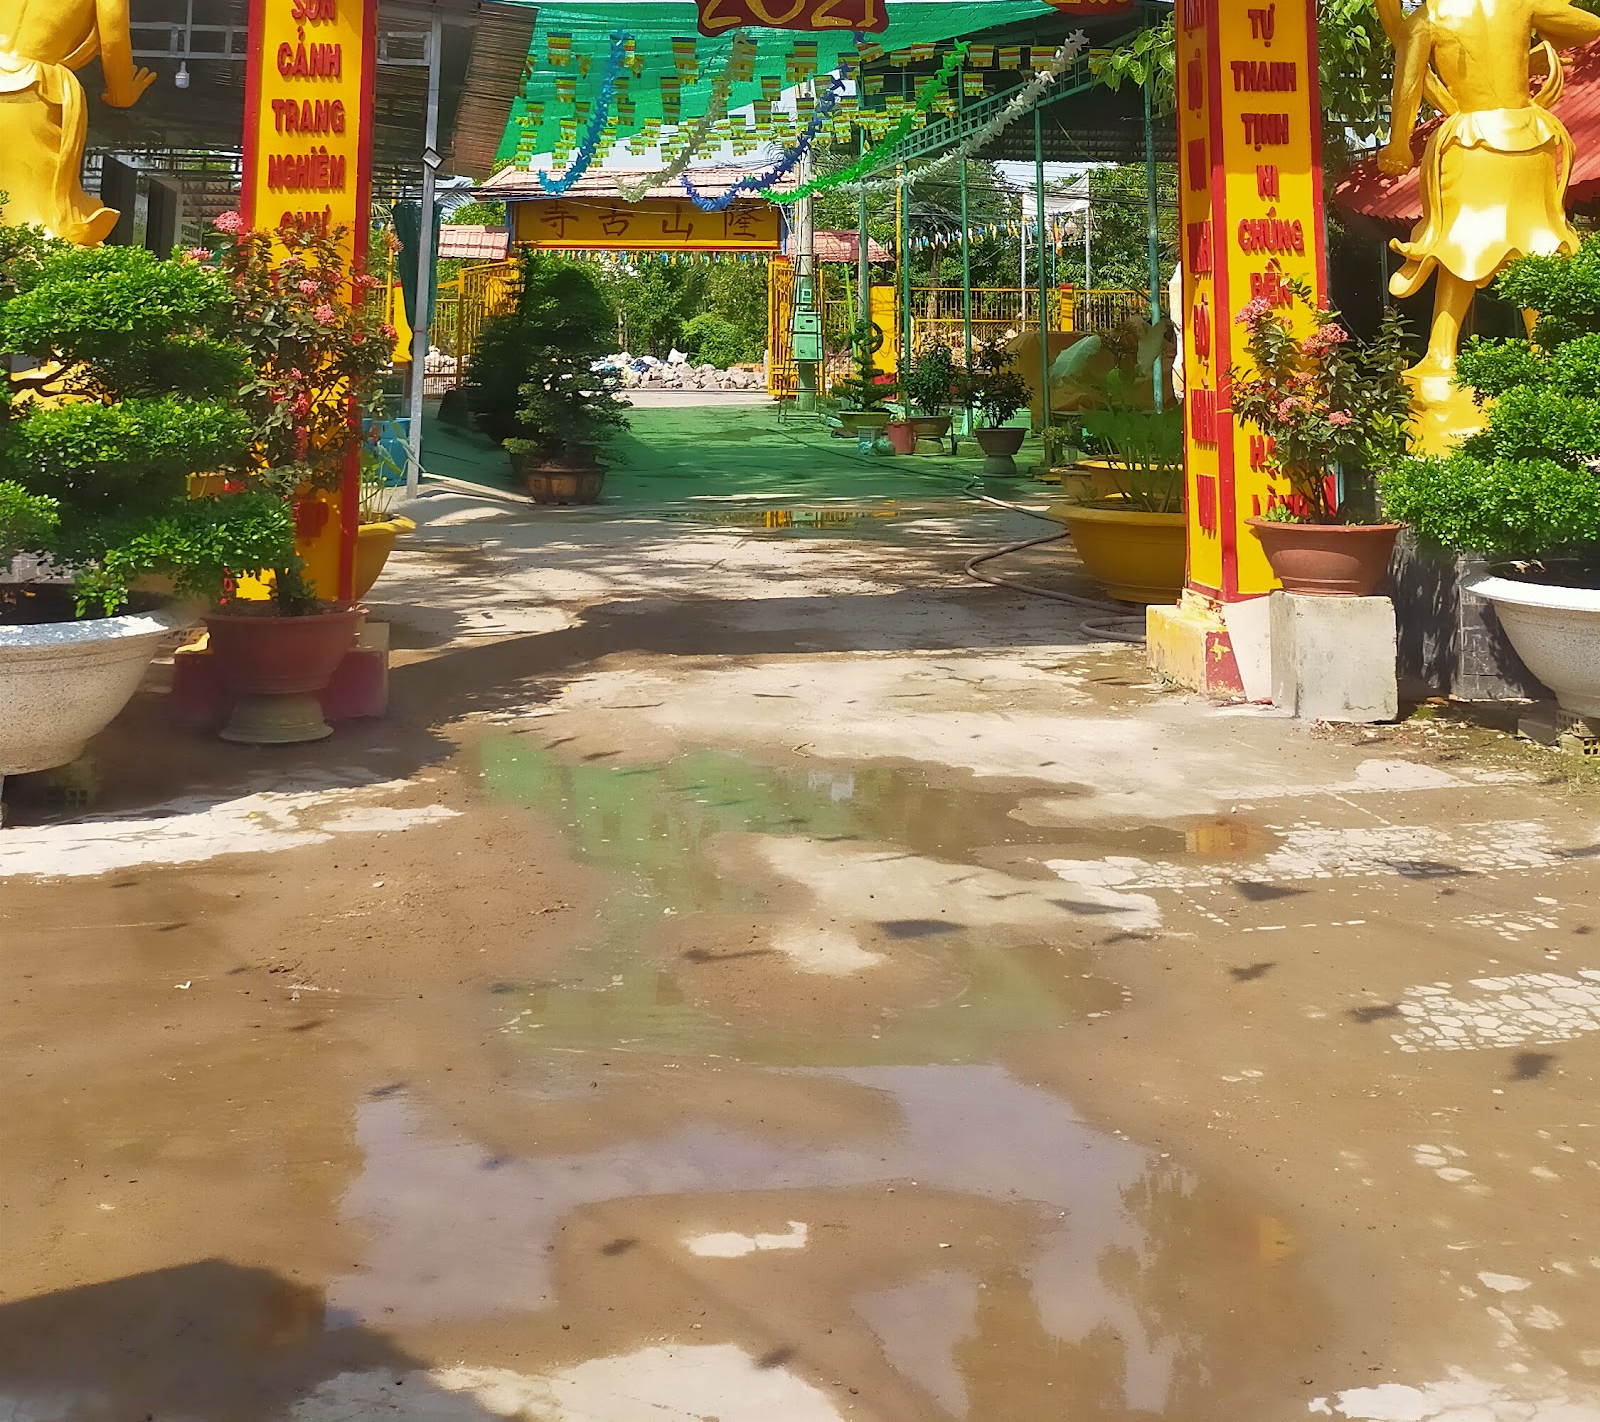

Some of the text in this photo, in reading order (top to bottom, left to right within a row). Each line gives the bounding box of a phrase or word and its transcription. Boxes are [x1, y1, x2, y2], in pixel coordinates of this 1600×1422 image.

[1248, 3, 1275, 48] TỰ
[277, 26, 341, 77] CẢNH
[1231, 61, 1297, 92] THANH
[272, 99, 345, 132] TRANG
[1241, 113, 1289, 152] TỊNH
[1256, 164, 1278, 196] NI
